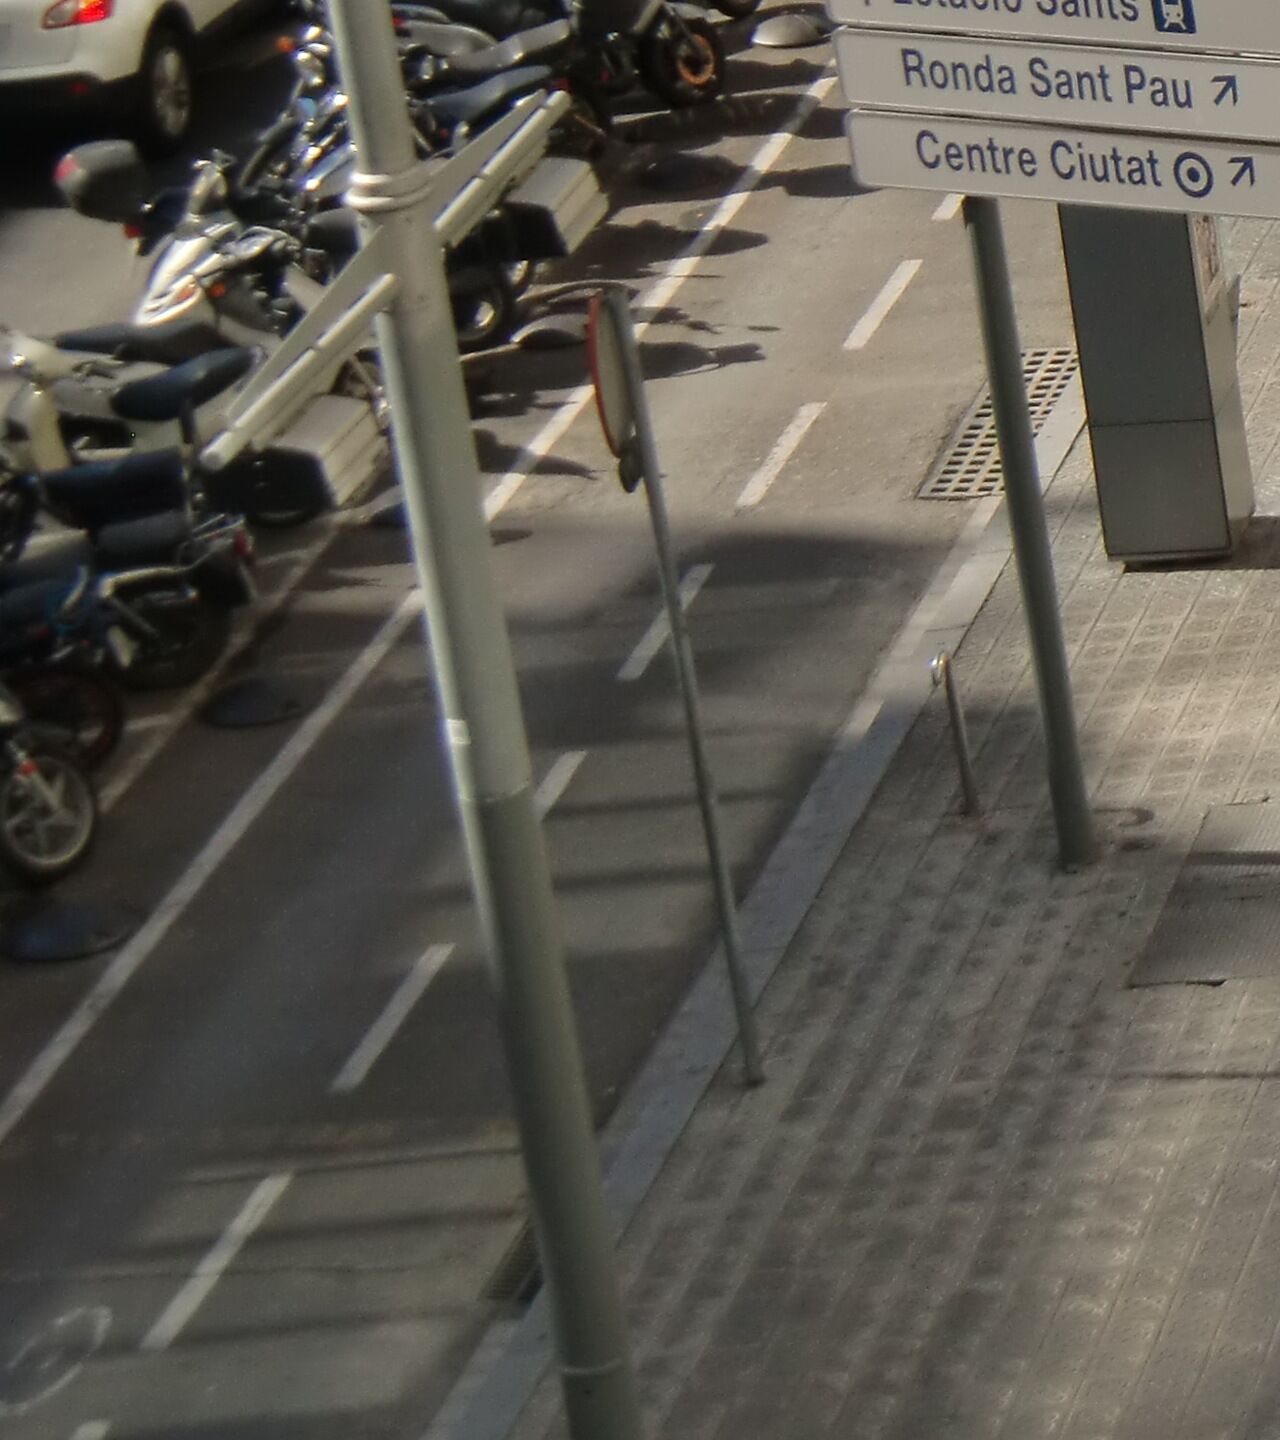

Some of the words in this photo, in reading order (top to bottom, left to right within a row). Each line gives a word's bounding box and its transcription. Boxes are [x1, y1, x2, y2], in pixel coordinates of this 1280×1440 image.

[901, 48, 1017, 96] Ronda
[1031, 58, 1110, 103] Sant
[1124, 64, 1194, 109] Pau
[916, 129, 1038, 178] Centre
[1049, 139, 1162, 188] Ciutat
